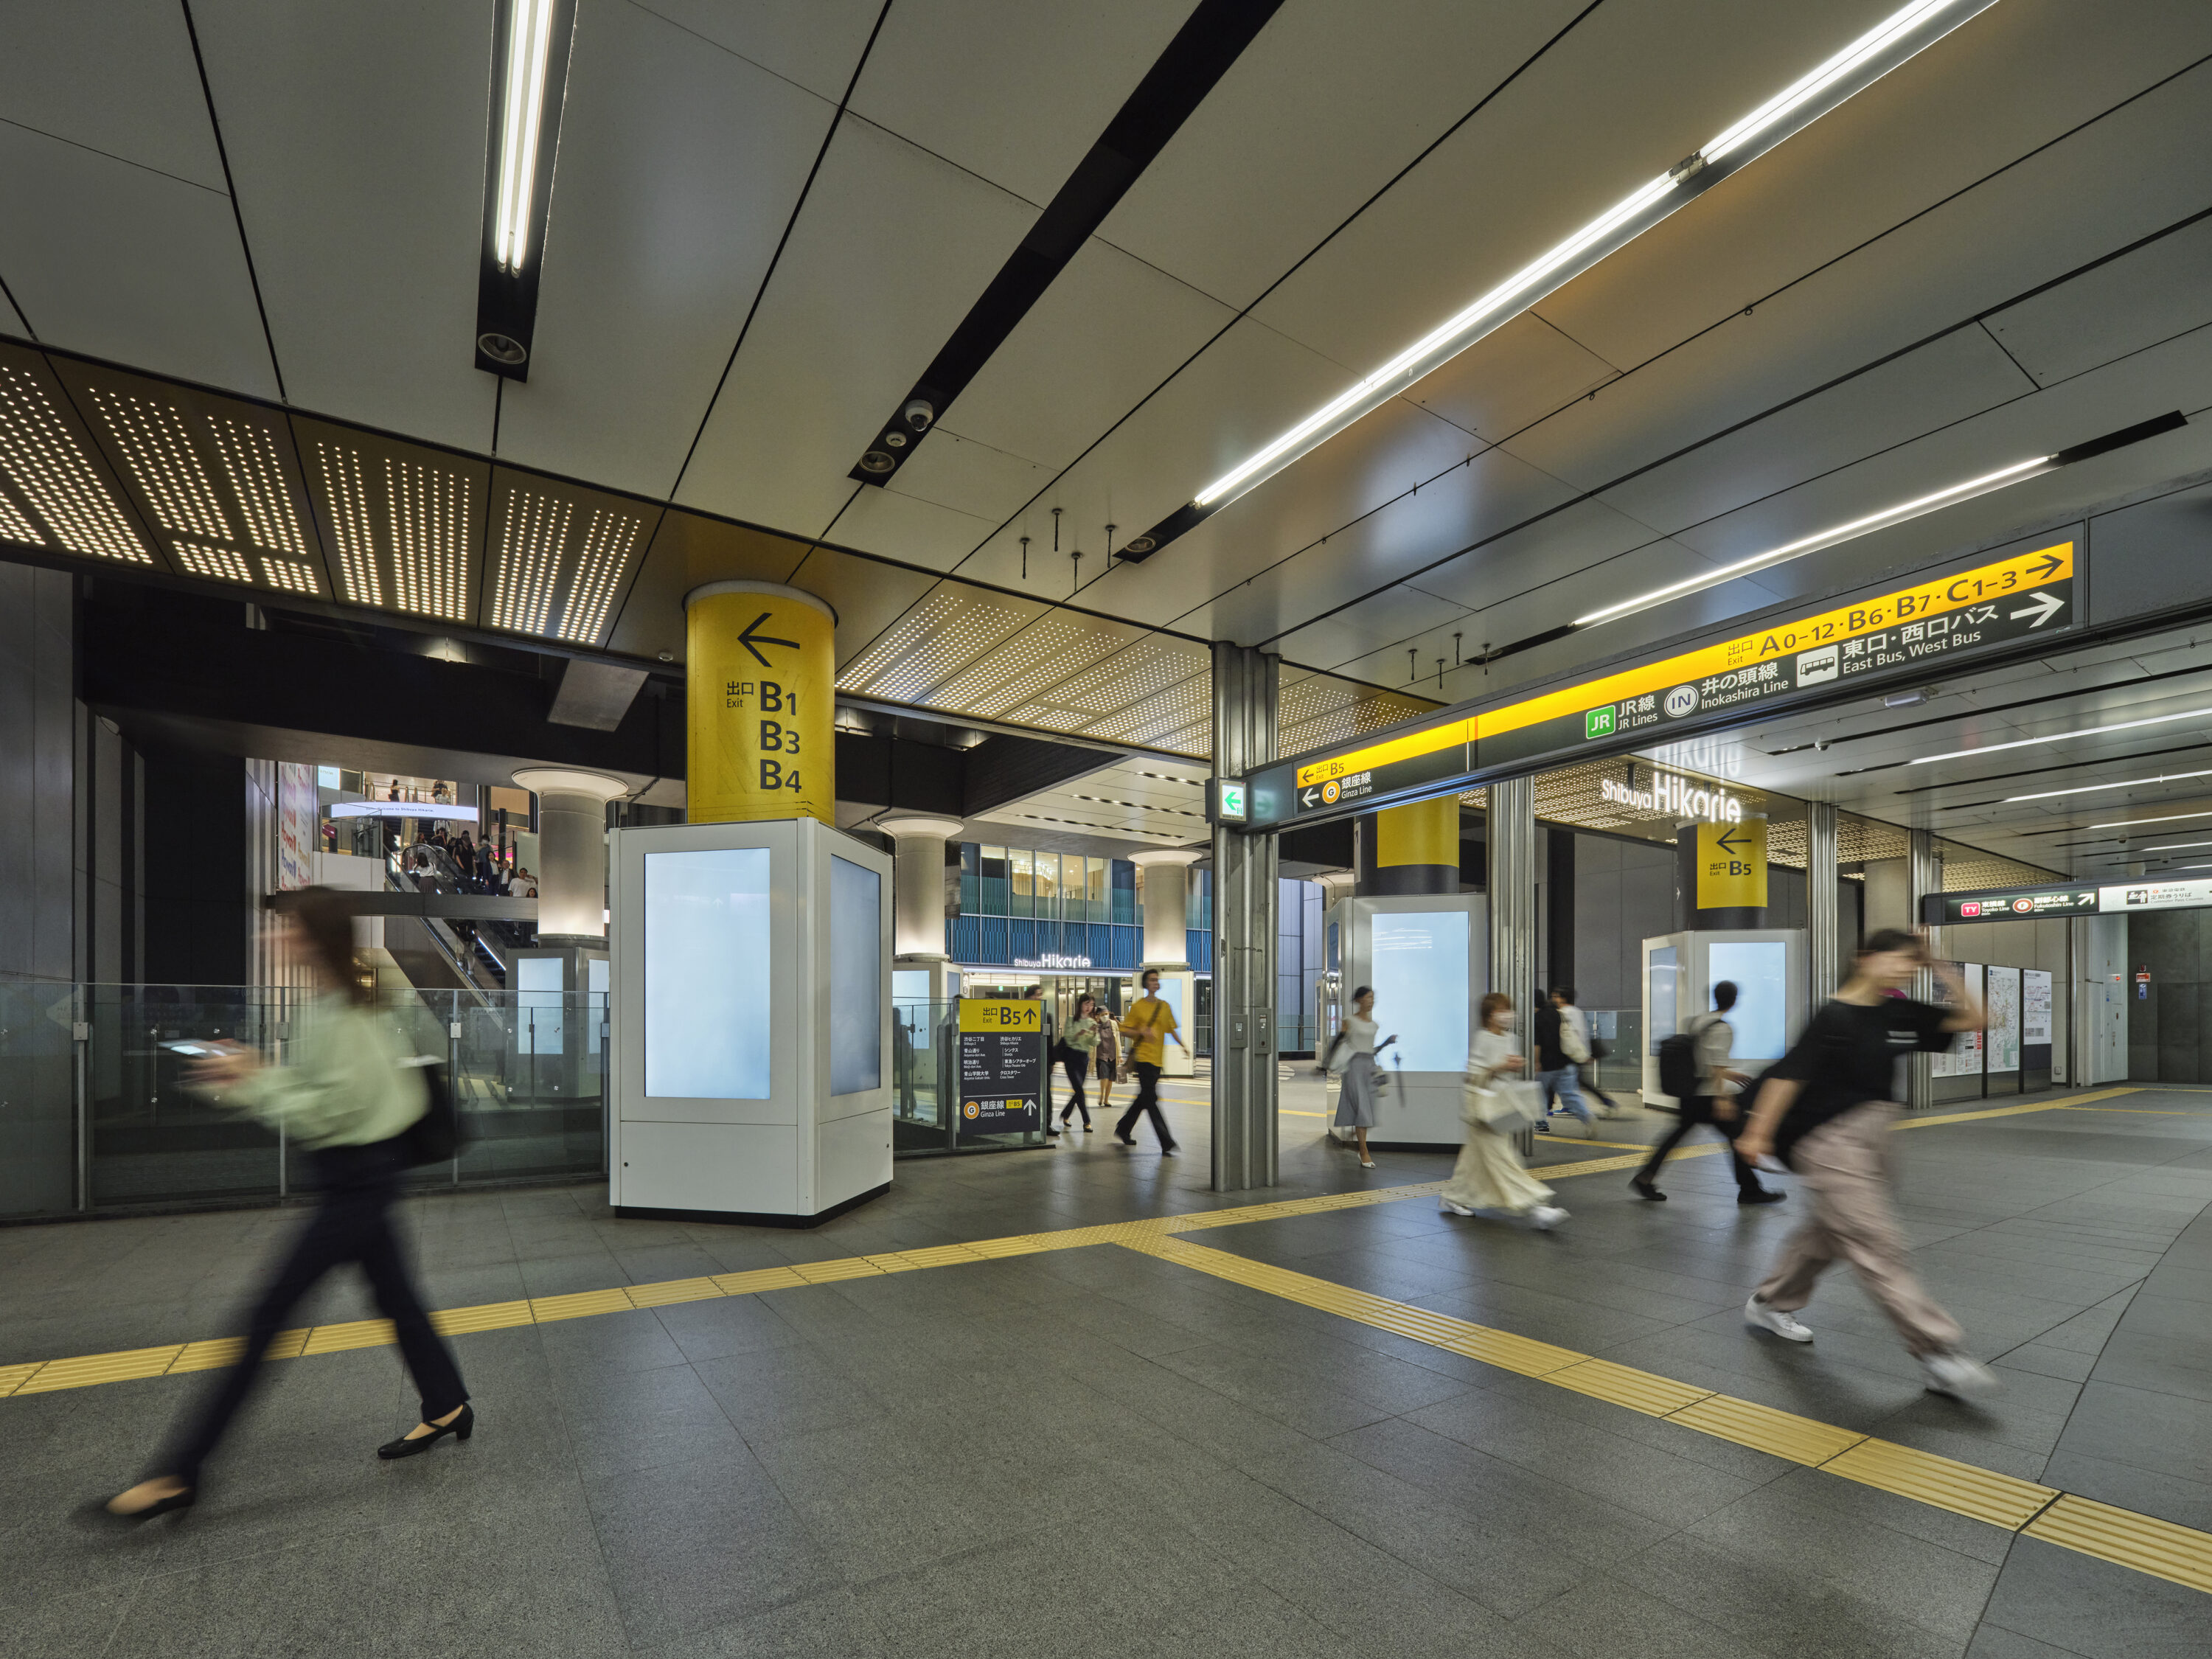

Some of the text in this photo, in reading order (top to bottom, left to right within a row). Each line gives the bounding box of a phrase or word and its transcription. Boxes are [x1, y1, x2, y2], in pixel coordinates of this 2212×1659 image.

[1728, 640, 1753, 657] 出口
[1843, 629, 1981, 674] East Bus, West Bus
[1728, 655, 1743, 666] Exit
[1702, 662, 1778, 697] 井の頭線
[726, 681, 754, 696] 出口
[1701, 679, 1789, 709] Inokashira Line
[726, 698, 744, 708] Exit
[760, 681, 796, 716] B1
[1618, 695, 1655, 718] JR線
[1672, 693, 1691, 711] IN
[1591, 714, 1610, 731] JR
[1618, 713, 1658, 731] JR Lines
[760, 720, 801, 754] B3
[760, 759, 802, 793] B4
[1330, 762, 1344, 776] B5
[1341, 771, 1371, 789] 銀座線
[1341, 785, 1372, 799] Ginza Line
[1601, 771, 1742, 824] Shibuya Hikarie
[1710, 862, 1726, 870] 出口
[1729, 860, 1752, 876] B5
[1015, 954, 1091, 968] Shibuya Hikarie
[983, 1007, 998, 1016] 出口
[1000, 1006, 1021, 1025] B5
[980, 1100, 1004, 1110] 銀座線
